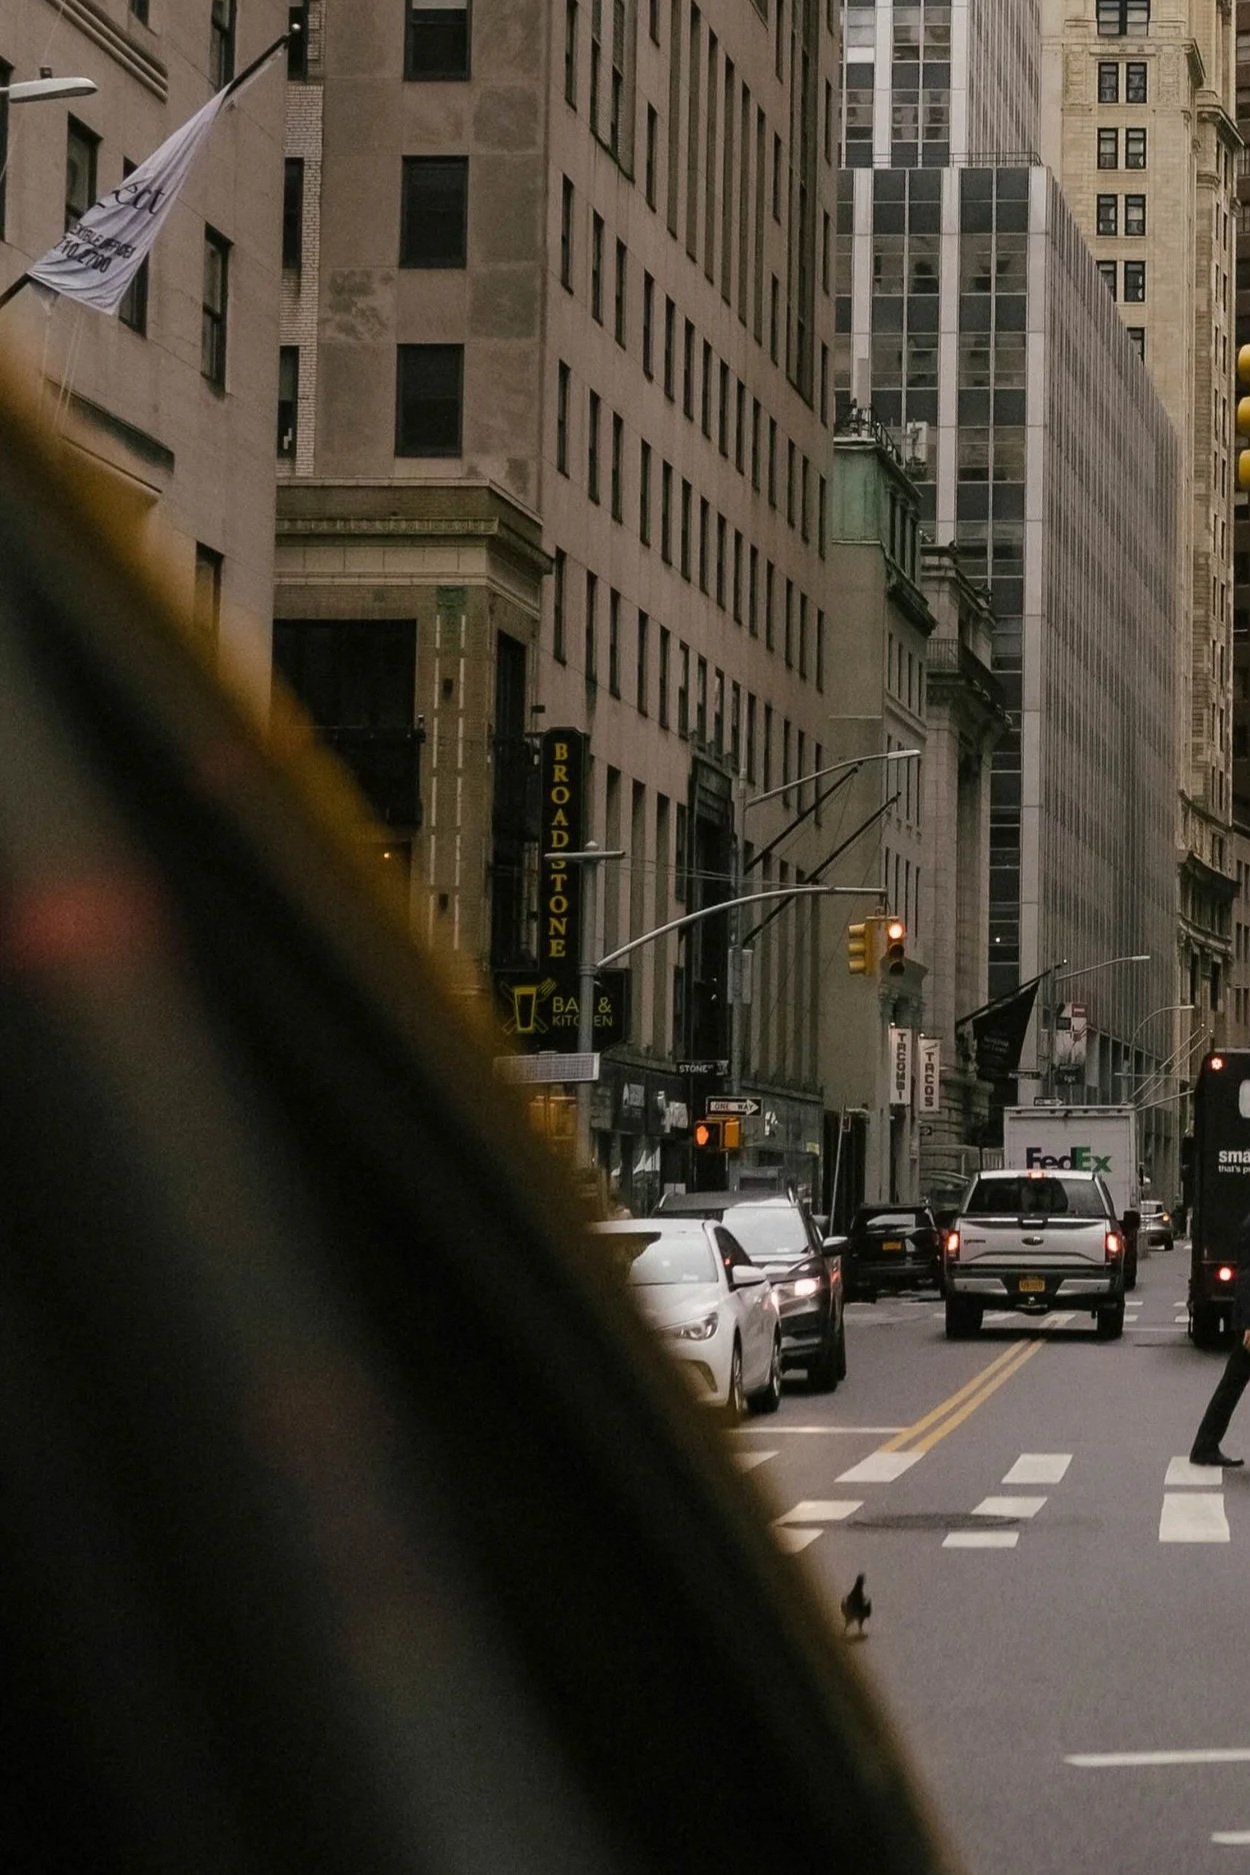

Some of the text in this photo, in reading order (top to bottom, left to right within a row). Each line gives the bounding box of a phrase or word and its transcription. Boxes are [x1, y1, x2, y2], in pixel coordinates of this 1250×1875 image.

[552, 996, 612, 1014] BA &
[552, 1014, 613, 1027] KITCEN
[924, 1052, 935, 1107] TACOS
[714, 1103, 753, 1111] ONE WAY
[1026, 1146, 1112, 1172] FedEx
